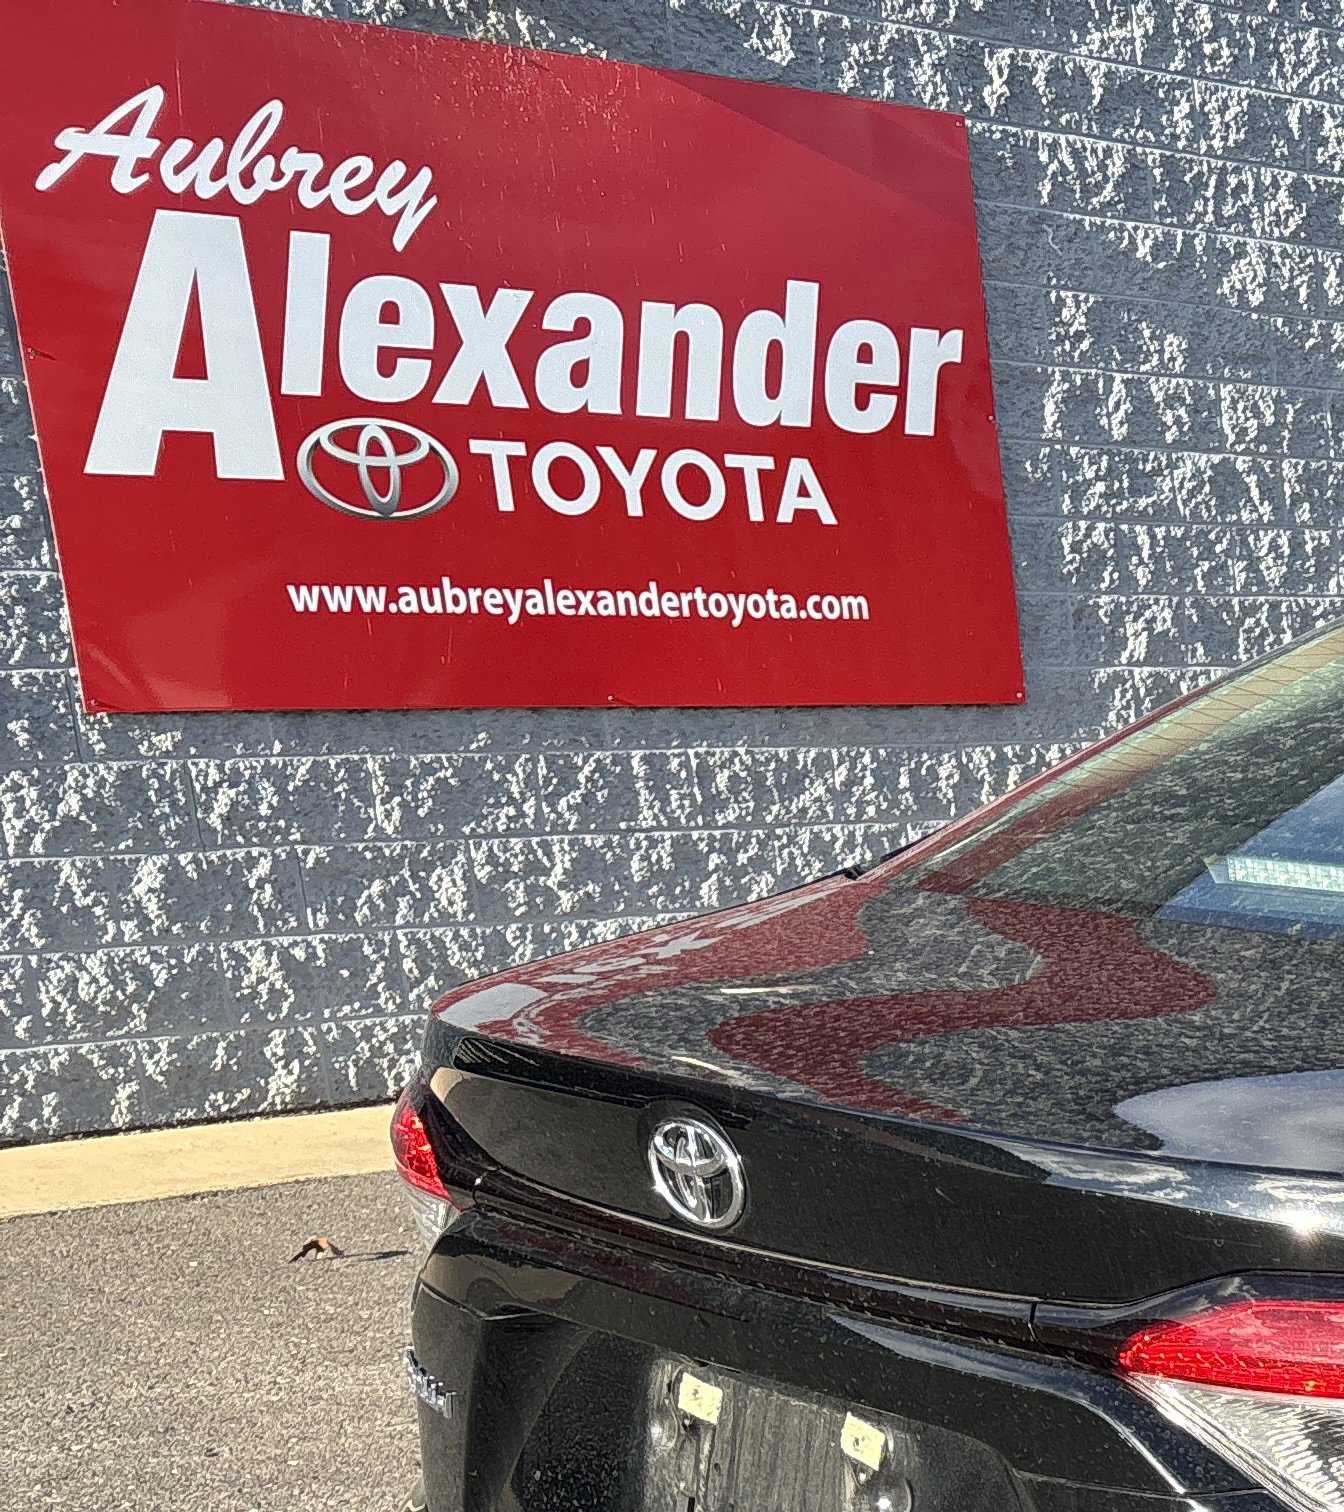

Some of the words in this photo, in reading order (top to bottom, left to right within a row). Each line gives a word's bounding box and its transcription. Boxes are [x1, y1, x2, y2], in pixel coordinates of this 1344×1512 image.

[35, 85, 438, 252] Aubrey
[84, 209, 963, 482] Alexander
[469, 438, 838, 525] TOYOTA
[287, 576, 869, 627] www.aubreyalexandertoyota.com
